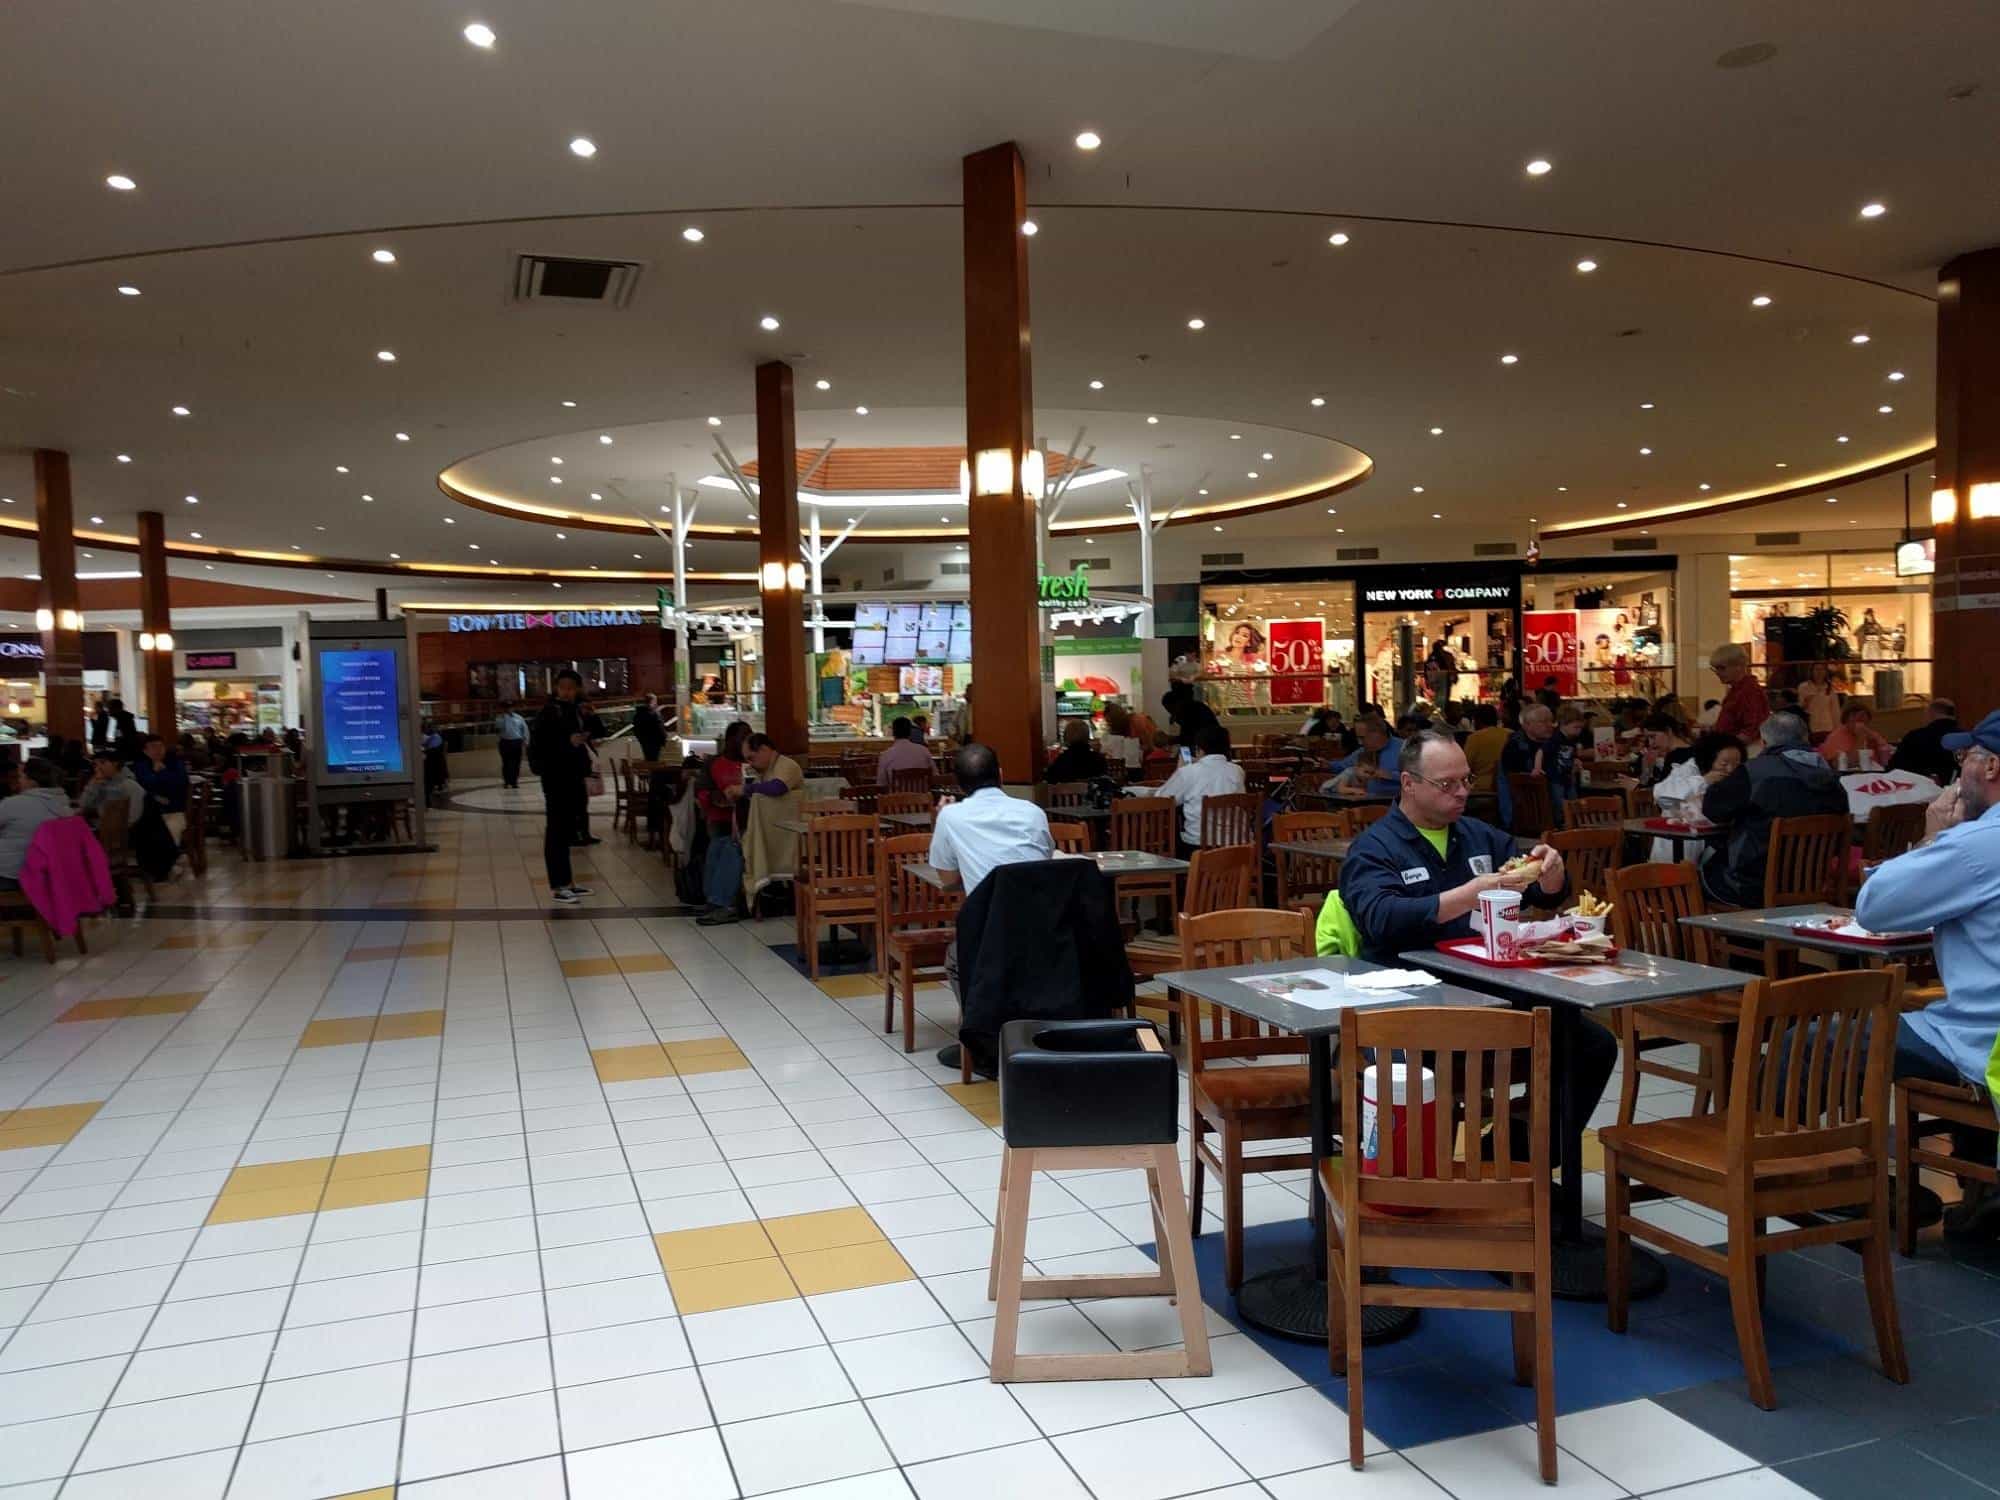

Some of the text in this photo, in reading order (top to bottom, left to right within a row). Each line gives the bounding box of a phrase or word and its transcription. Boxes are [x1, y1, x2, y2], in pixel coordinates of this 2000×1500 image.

[1036, 560, 1090, 598] resh
[1365, 589, 1397, 601] NEW
[1398, 588, 1434, 600] YORK
[1444, 586, 1511, 600] COMPANY
[448, 609, 641, 633] BOW TIE CINEMAS
